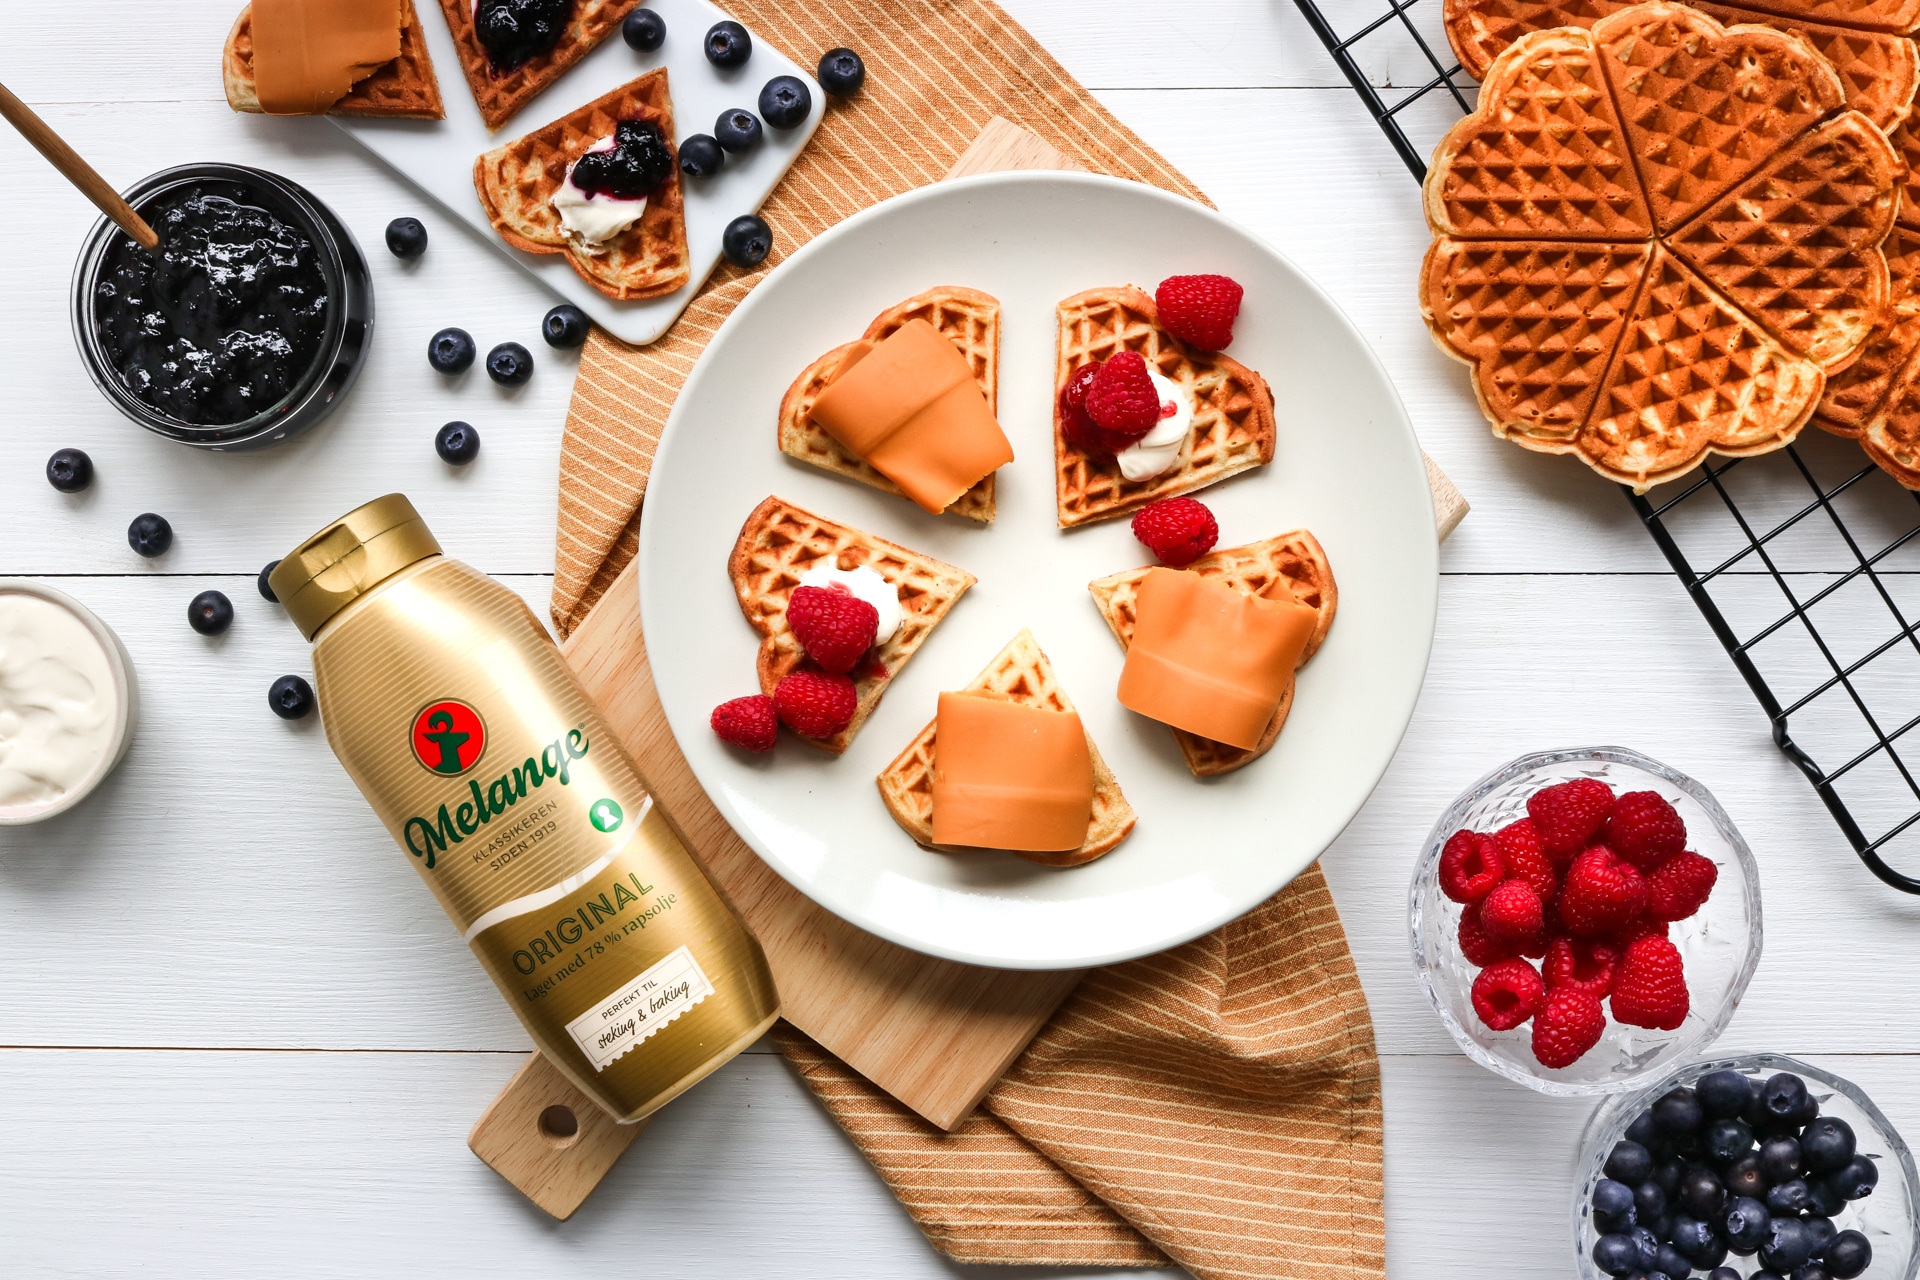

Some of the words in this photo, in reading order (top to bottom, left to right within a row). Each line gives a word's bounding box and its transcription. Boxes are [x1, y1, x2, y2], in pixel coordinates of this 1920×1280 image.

[473, 800, 557, 863] KLASSIKEREN
[490, 841, 528, 871] SIDEN
[529, 821, 557, 843] 1919
[513, 872, 653, 975] ORIGINAL
[555, 953, 586, 982] med
[584, 941, 605, 959] 78
[604, 931, 621, 946] %
[622, 893, 677, 935] rapsolje
[598, 1018, 635, 1049] steking
[638, 1008, 647, 1022] &
[649, 981, 690, 1013] baking
[601, 990, 641, 1020] PERFEKT
[642, 980, 658, 992] TIL
